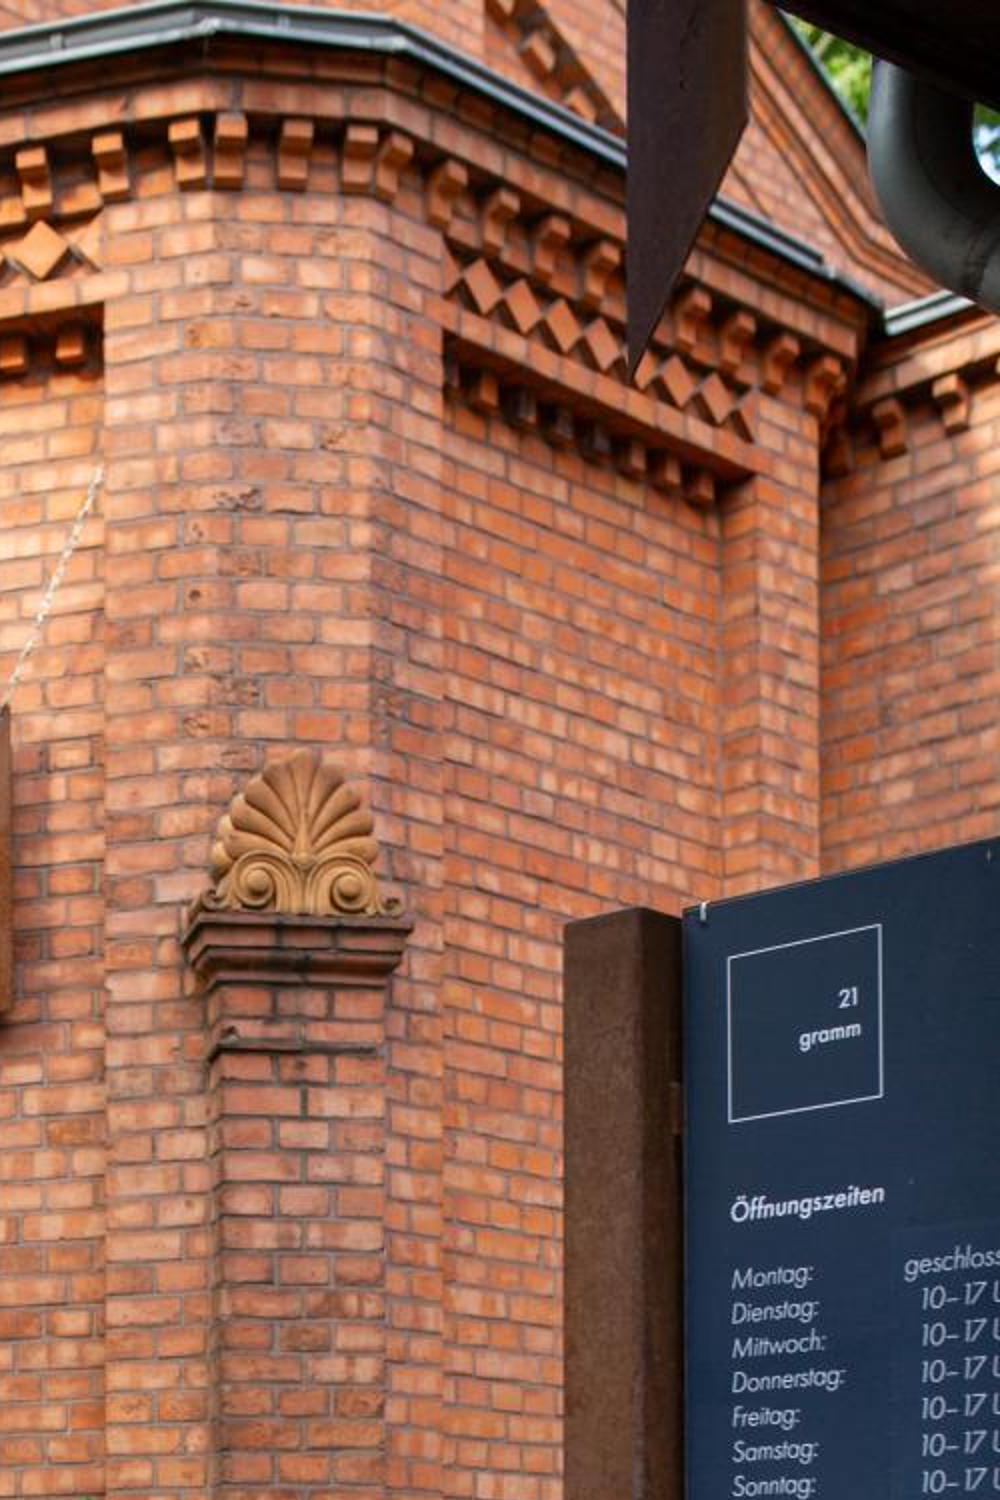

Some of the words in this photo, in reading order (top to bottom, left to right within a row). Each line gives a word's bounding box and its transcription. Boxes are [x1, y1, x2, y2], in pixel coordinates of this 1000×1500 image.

[838, 986, 858, 1009] 21
[799, 1023, 862, 1053] gramm
[730, 1185, 886, 1223] Öffnungszeiten
[731, 1266, 815, 1290] Montag:
[731, 1301, 821, 1325] Dienstag:
[731, 1328, 828, 1359] Mittwoch:
[731, 1368, 848, 1393] Donnerstag:
[731, 1405, 801, 1431] Freitag:
[731, 1440, 820, 1465] Samstag:
[731, 1475, 817, 1500] Sonntag:
